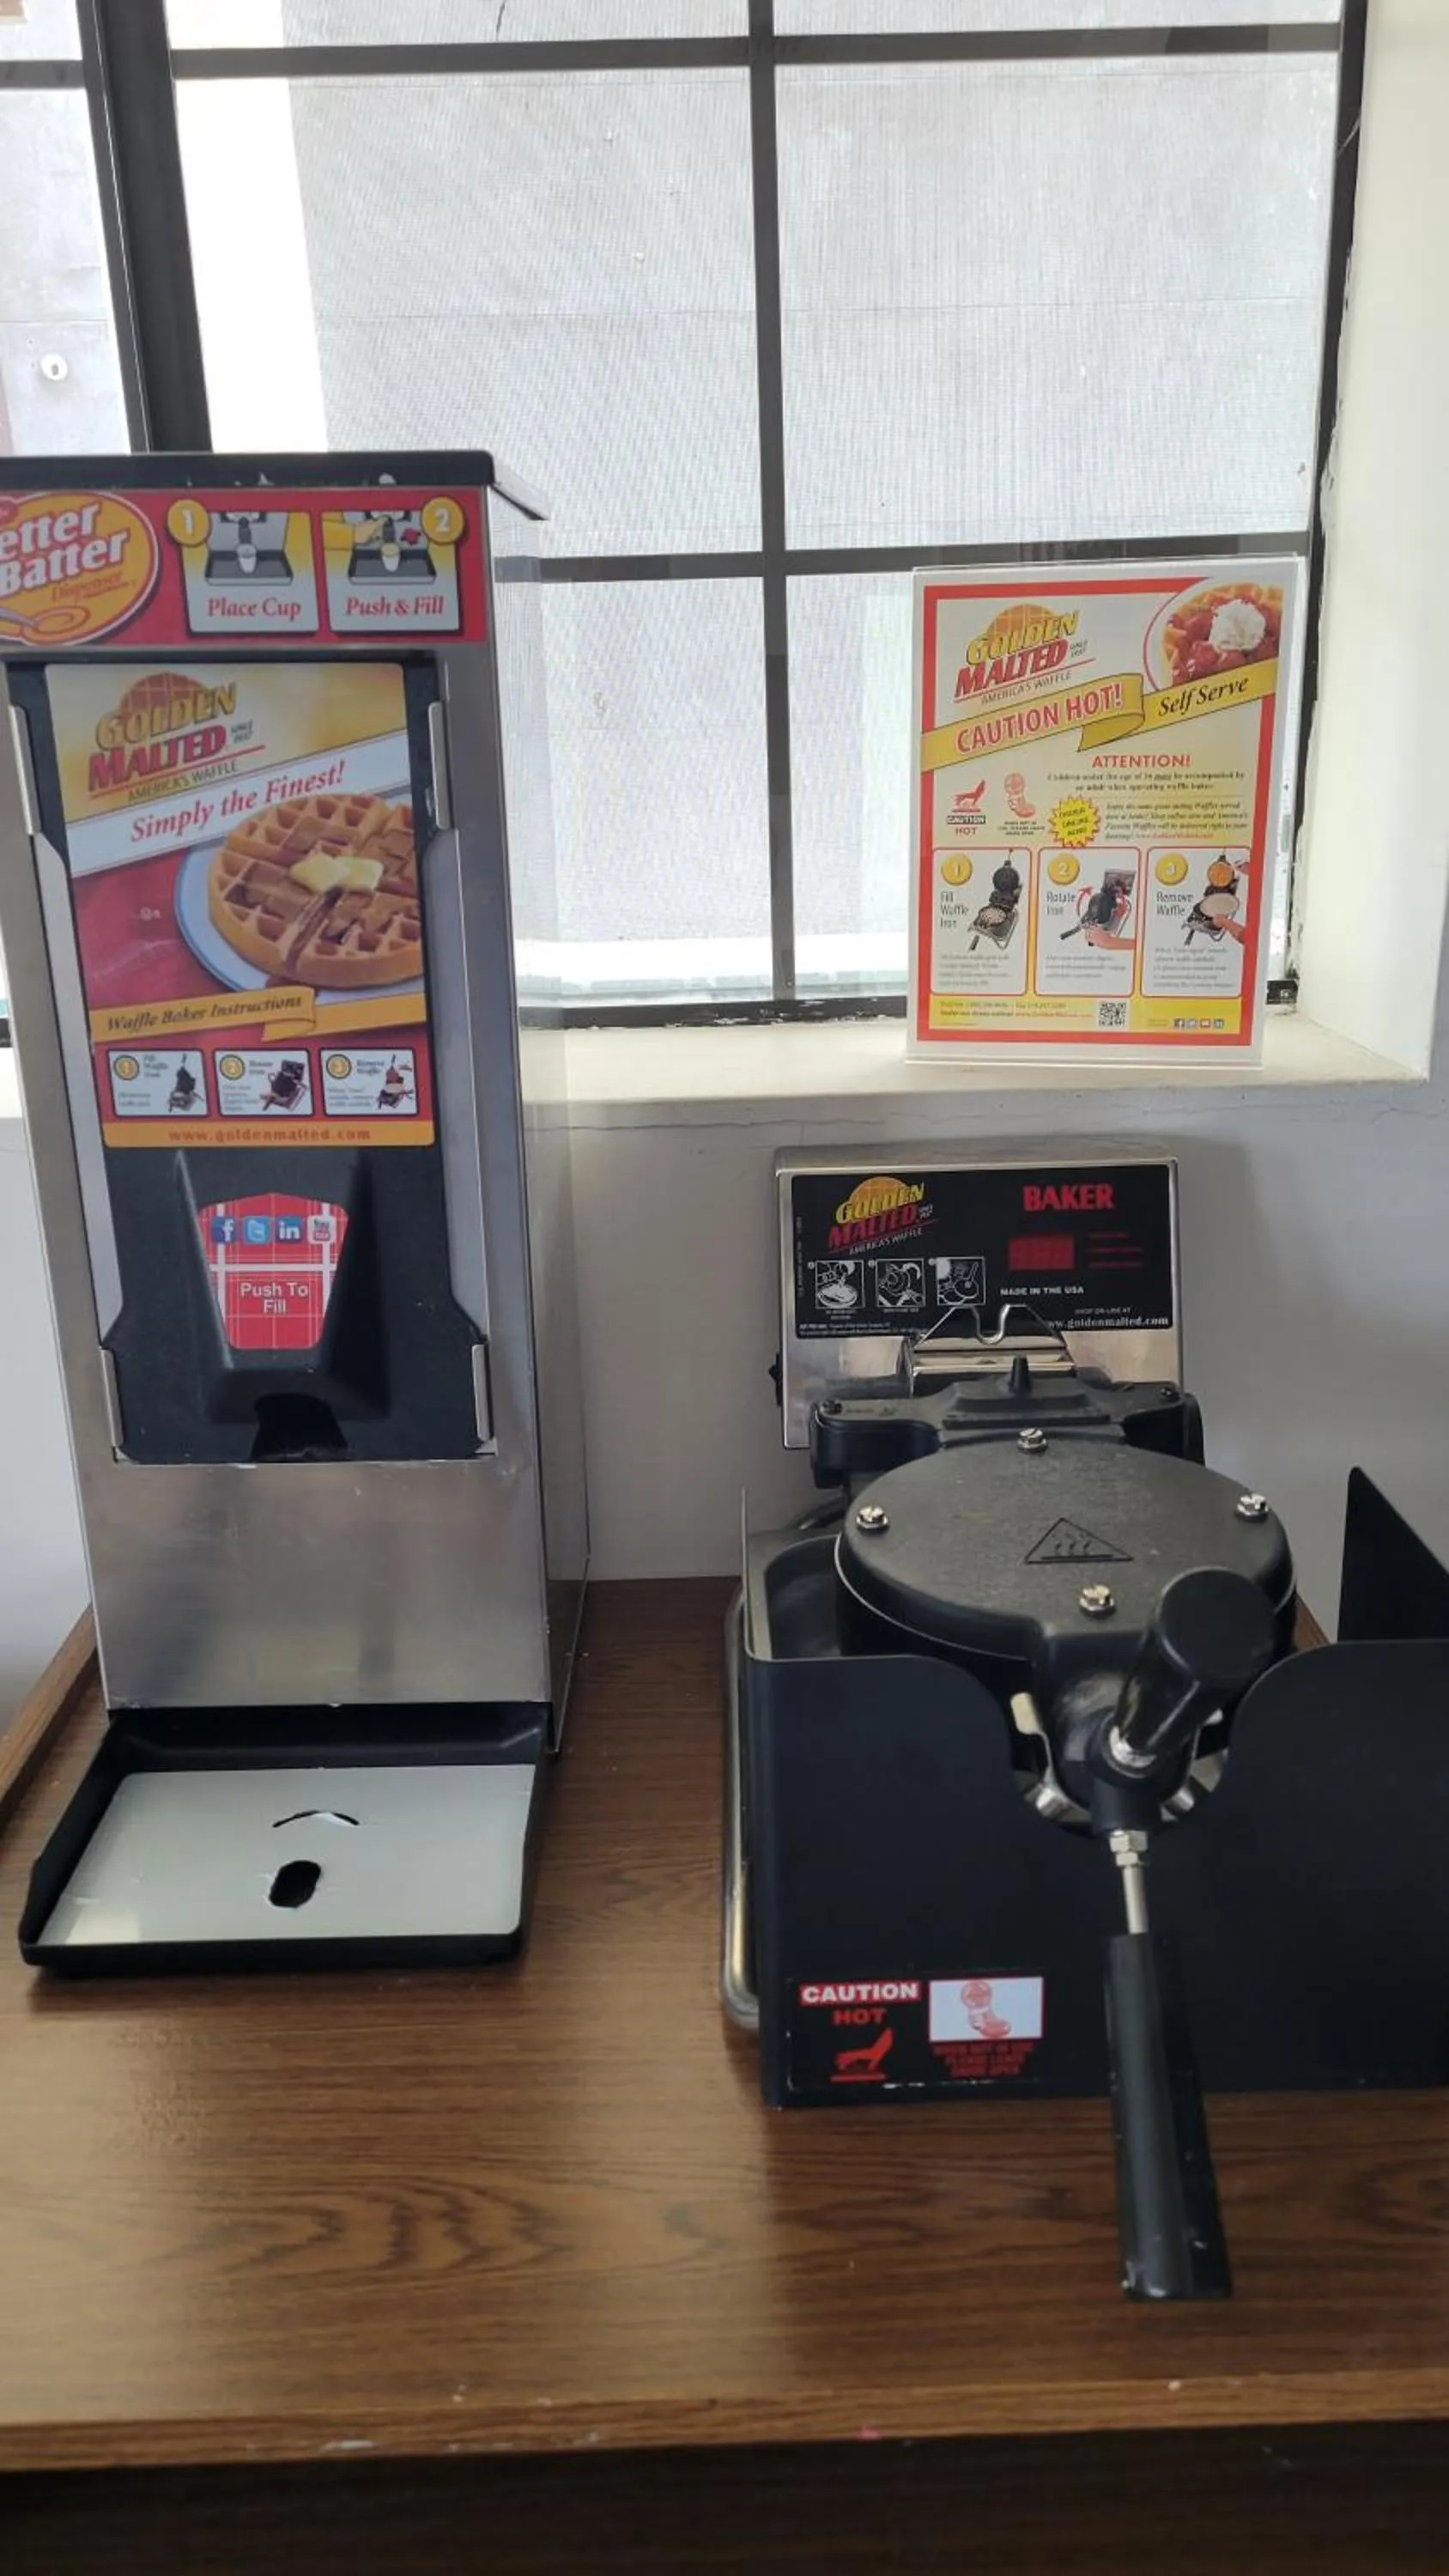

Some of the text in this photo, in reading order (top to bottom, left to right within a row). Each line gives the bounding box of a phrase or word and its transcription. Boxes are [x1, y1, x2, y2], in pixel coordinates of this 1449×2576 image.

[0, 503, 100, 559] etter
[183, 509, 193, 536] 1
[434, 507, 451, 532] 2
[0, 531, 129, 598] Batter
[208, 598, 301, 621] Place Cup
[346, 595, 445, 615] Push & Fill
[967, 610, 1080, 665] GOLDEN
[954, 638, 1069, 698] MALTED
[1158, 677, 1248, 717] Self Serve
[95, 682, 238, 750] GOLDEN
[956, 683, 1123, 753] CAUTION HOT!
[88, 725, 227, 792] MALTED
[1092, 755, 1191, 769] ATTENTION!
[192, 759, 238, 785] WAFFLE
[131, 759, 346, 842] Simply the Finest!
[955, 827, 977, 835] HOT
[1058, 862, 1070, 876] 2
[940, 891, 955, 902] Fill
[1046, 891, 1076, 902] Rotate
[1156, 891, 1194, 902] Remove
[940, 904, 969, 916] Waffle
[1156, 905, 1186, 916] Waffle
[107, 995, 303, 1034] Waffle Baker Instructions
[169, 1127, 371, 1143] www.goldenmalted.com
[835, 1181, 925, 1224] GOLDEN
[1022, 1182, 1115, 1212] BAKER
[828, 1203, 919, 1249] MALTED
[240, 1282, 309, 1297] Push To
[1000, 1287, 1028, 1296] MADE
[1043, 1286, 1062, 1295] THE
[1064, 1285, 1084, 1294] USA
[264, 1298, 287, 1314] Fill
[1046, 1315, 1168, 1329] ww.goldenmalted.com
[801, 1982, 919, 2003] CAUTION
[832, 2008, 887, 2026] HOT
